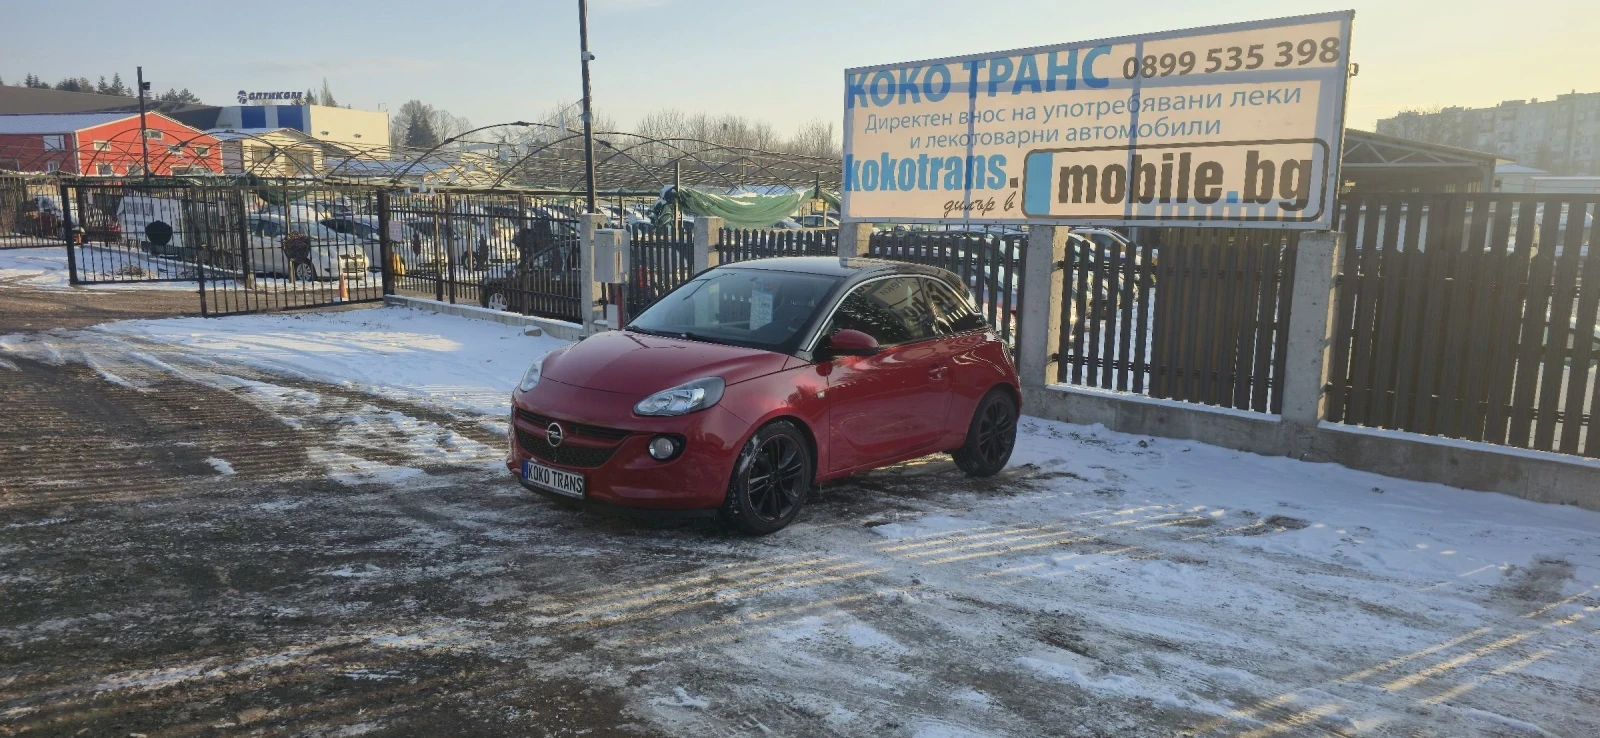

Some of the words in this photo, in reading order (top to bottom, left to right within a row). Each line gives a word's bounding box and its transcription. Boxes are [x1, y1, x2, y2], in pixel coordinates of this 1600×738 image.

[847, 64, 952, 109] КОКО
[962, 45, 1112, 98] ТРАНС
[1122, 50, 1196, 80] 0899
[1204, 43, 1265, 74] 535
[1274, 36, 1341, 68] 398
[864, 111, 953, 135] Директен
[958, 108, 1006, 126] внос
[1012, 104, 1037, 121] на
[1042, 92, 1222, 125] употребявани
[1230, 87, 1301, 108] леки
[910, 136, 921, 149] и
[925, 127, 1059, 150] лекотоварни
[1065, 116, 1221, 142] автомобили
[1058, 150, 1313, 212] mobile.bg
[528, 464, 550, 484] KOKO
[552, 471, 582, 494] TRANS
